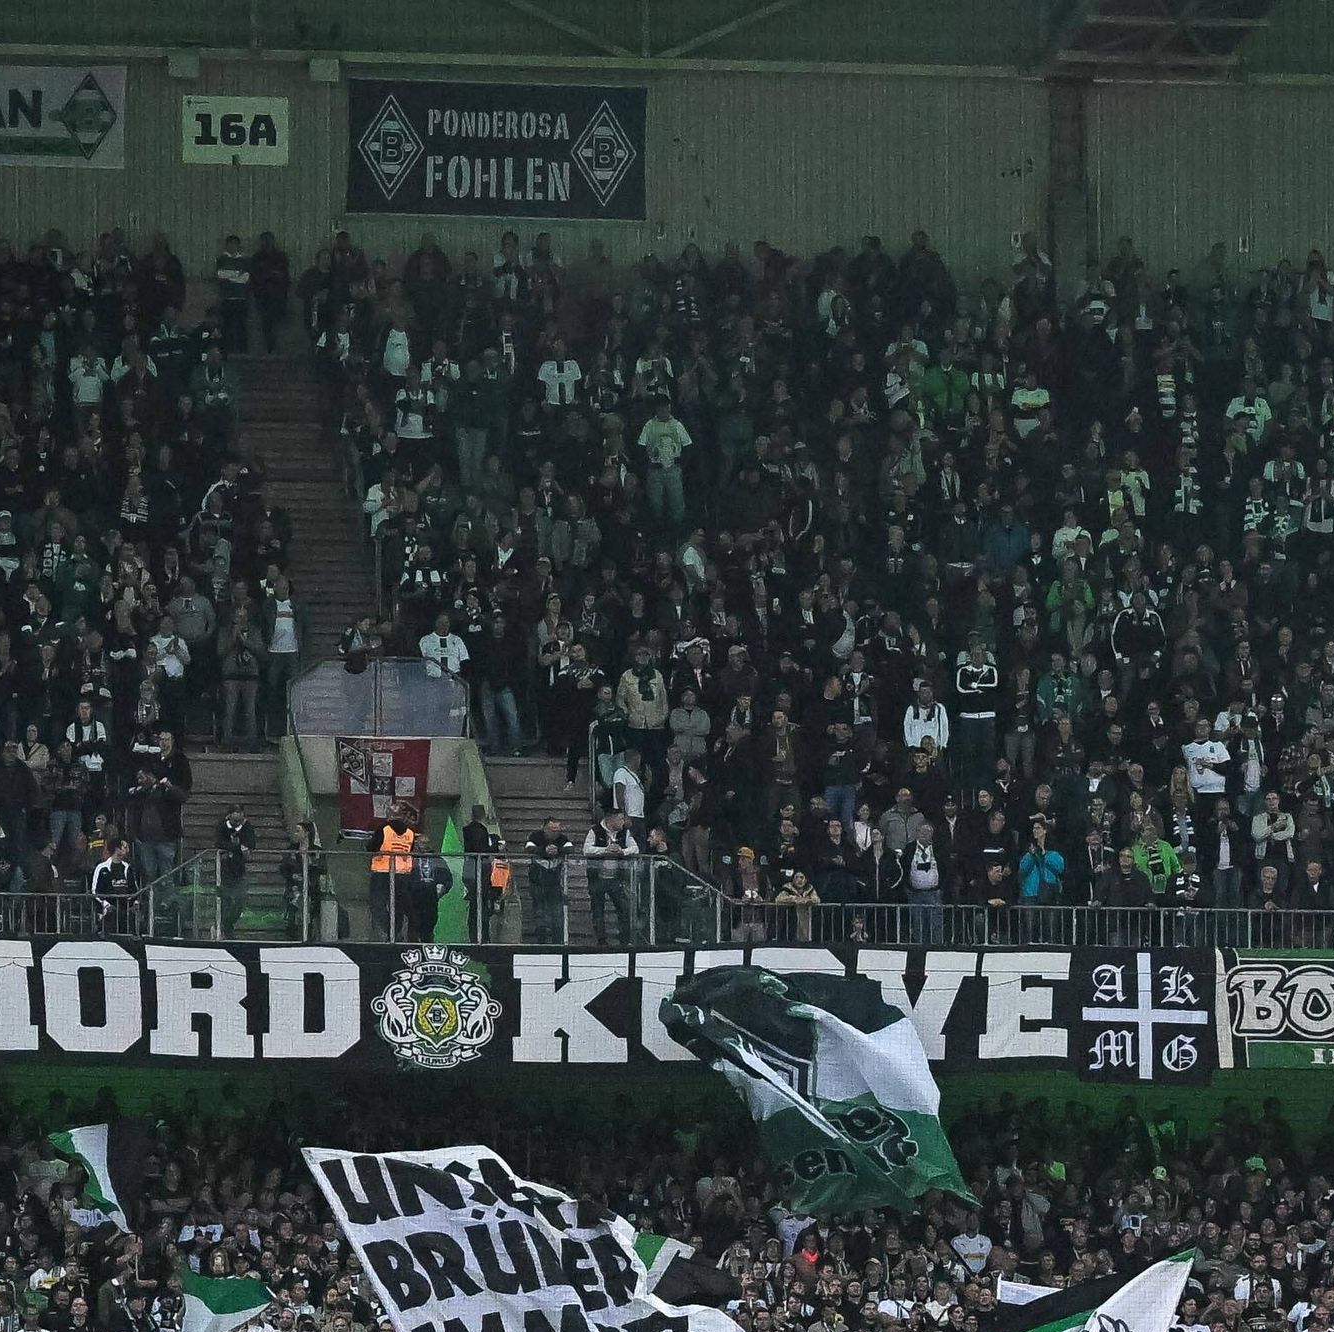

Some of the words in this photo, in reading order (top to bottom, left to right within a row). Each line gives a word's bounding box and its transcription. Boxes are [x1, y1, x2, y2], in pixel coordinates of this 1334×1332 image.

[194, 112, 277, 147] 16A
[427, 108, 569, 141] PONDEROSA
[426, 155, 570, 202] FOHLEN
